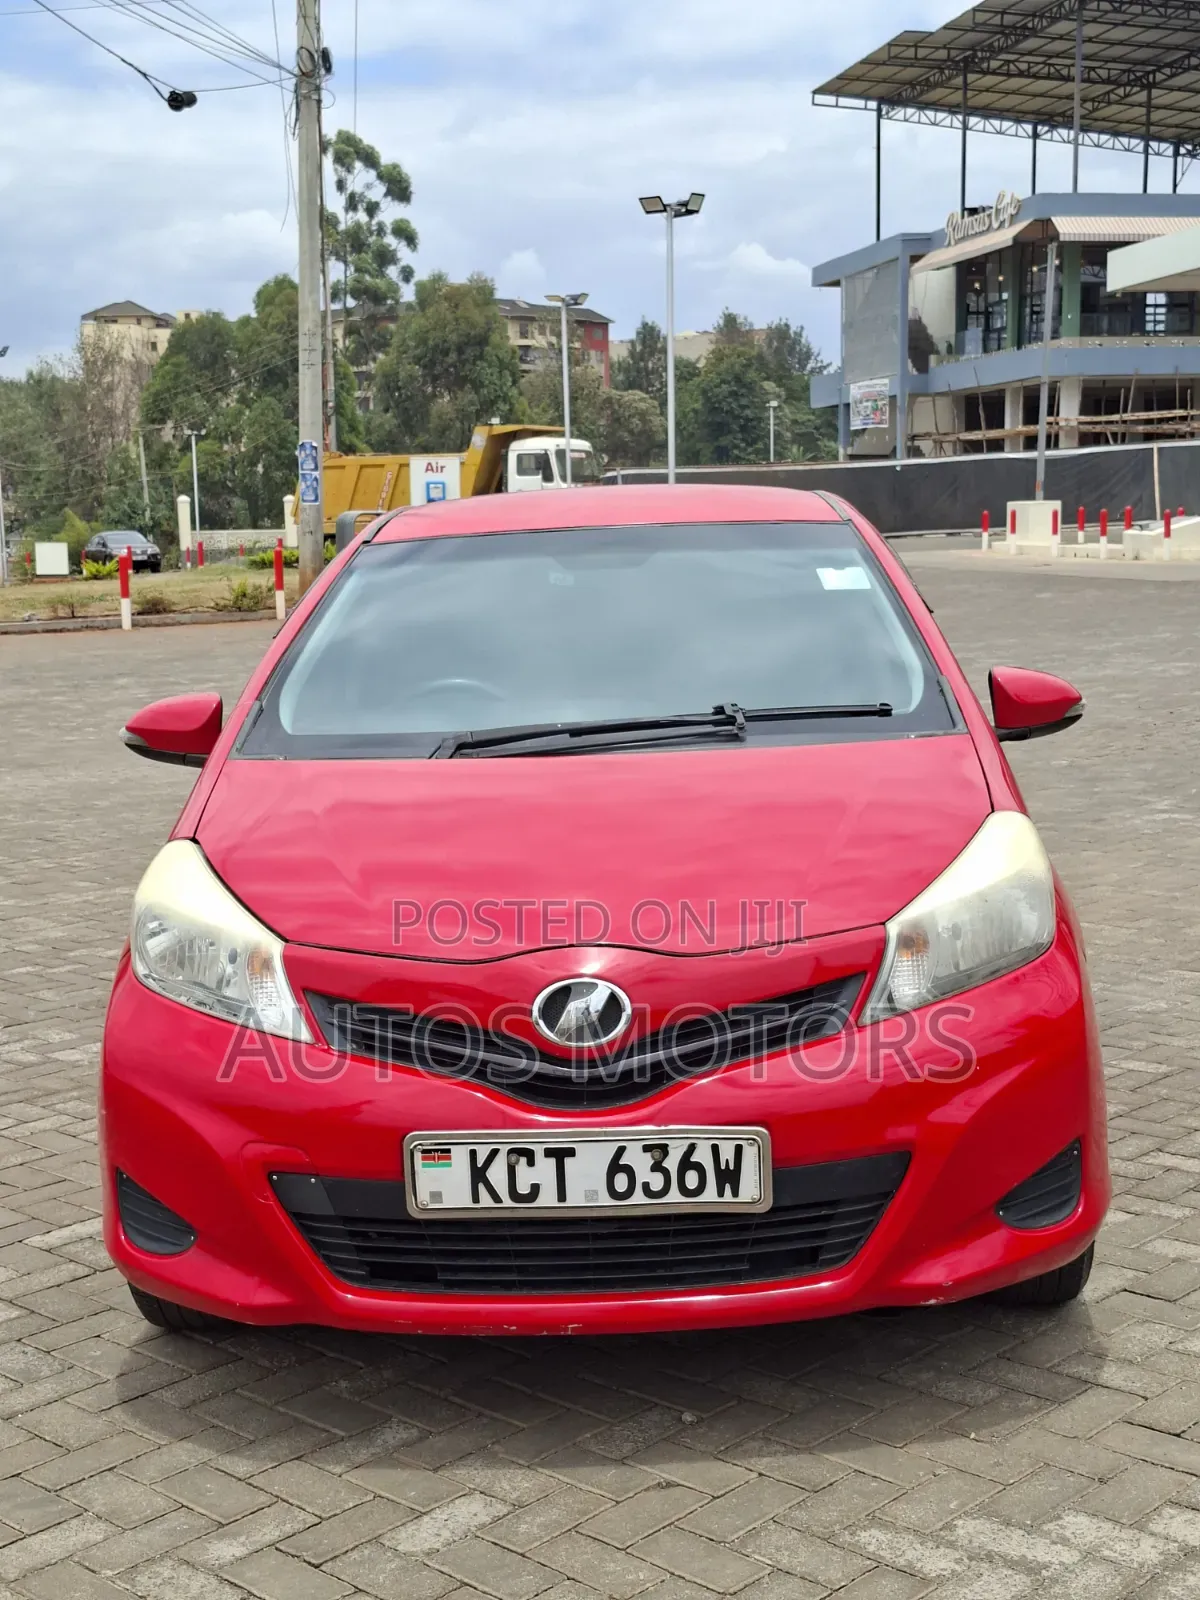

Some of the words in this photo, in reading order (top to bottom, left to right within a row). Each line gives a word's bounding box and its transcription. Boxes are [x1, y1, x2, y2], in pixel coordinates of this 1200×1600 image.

[424, 462, 446, 474] Air
[469, 1146, 576, 1205] KCT
[606, 1142, 744, 1202] 636W
